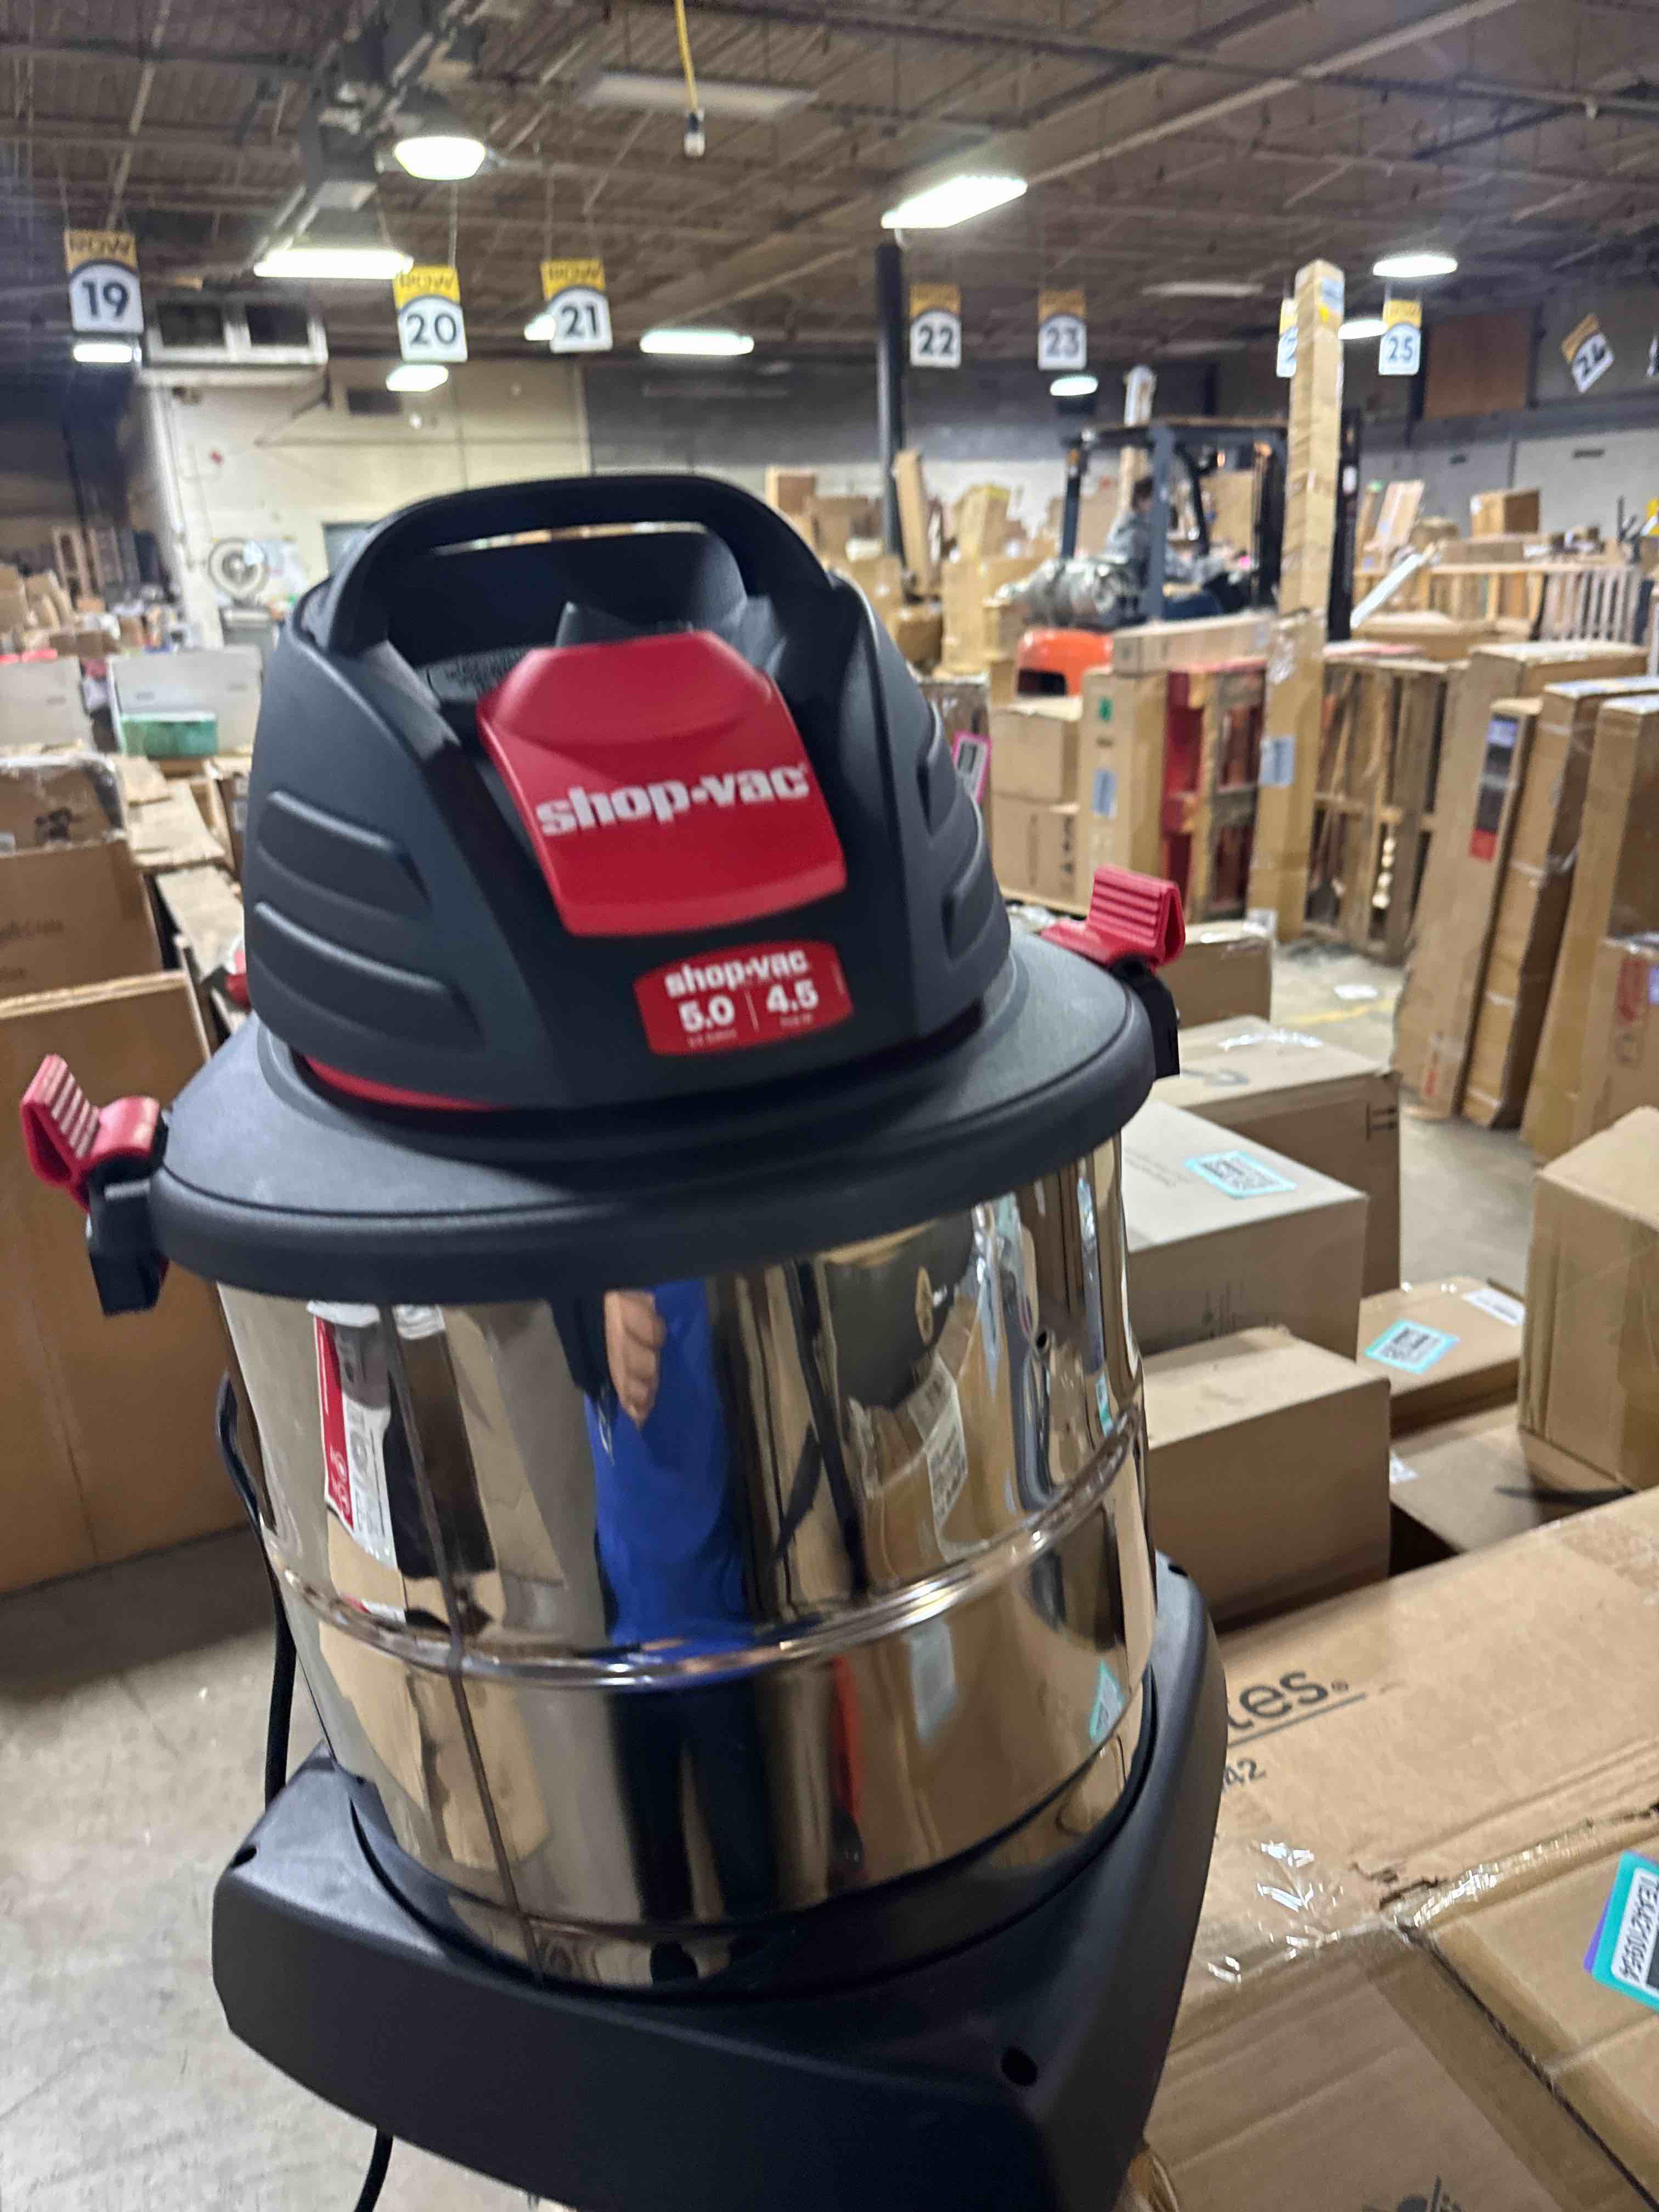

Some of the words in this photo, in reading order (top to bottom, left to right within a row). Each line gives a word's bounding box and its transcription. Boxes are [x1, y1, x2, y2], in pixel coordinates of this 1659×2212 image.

[82, 280, 129, 317] 19
[407, 313, 458, 345] 20
[562, 304, 598, 337] 21
[919, 325, 953, 355] 22
[1046, 328, 1080, 358] 23
[1387, 336, 1413, 362] 25
[766, 979, 819, 1013] 4.5
